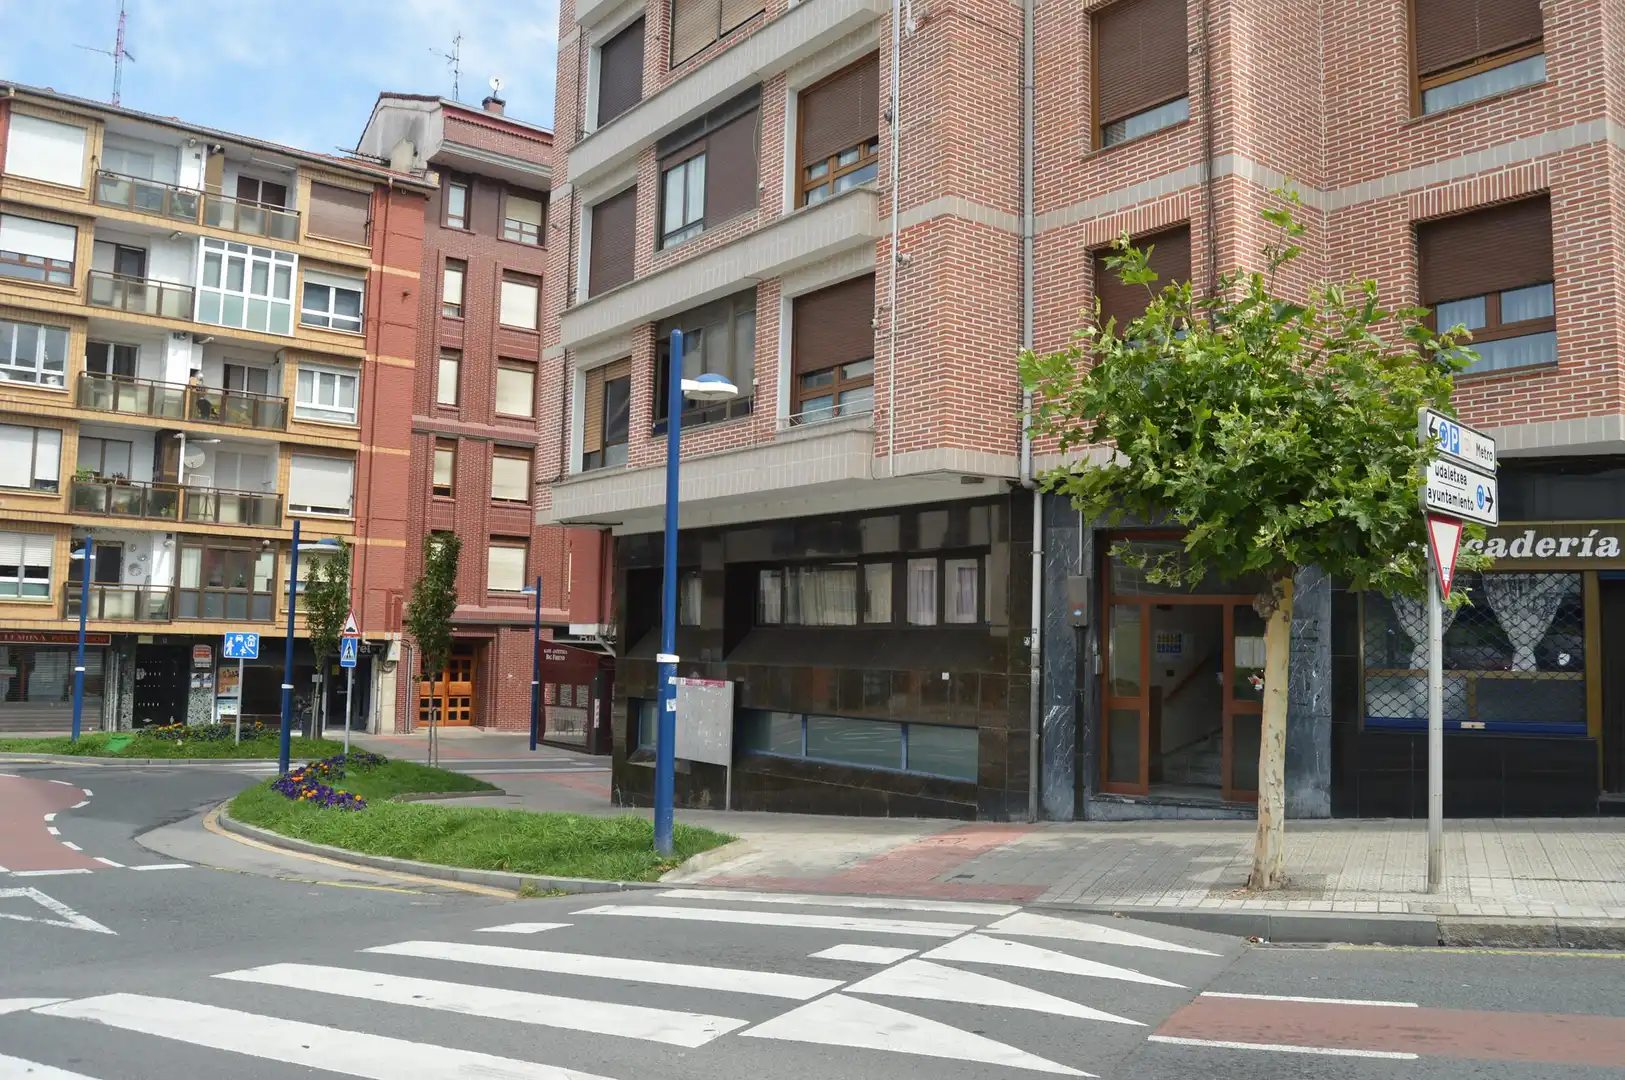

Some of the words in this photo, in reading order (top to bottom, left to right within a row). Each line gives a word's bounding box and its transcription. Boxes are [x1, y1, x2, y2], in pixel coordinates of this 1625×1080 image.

[1476, 442, 1493, 462] Metro
[1434, 464, 1468, 486] udaletxea
[1427, 487, 1475, 511] ayuntamiento
